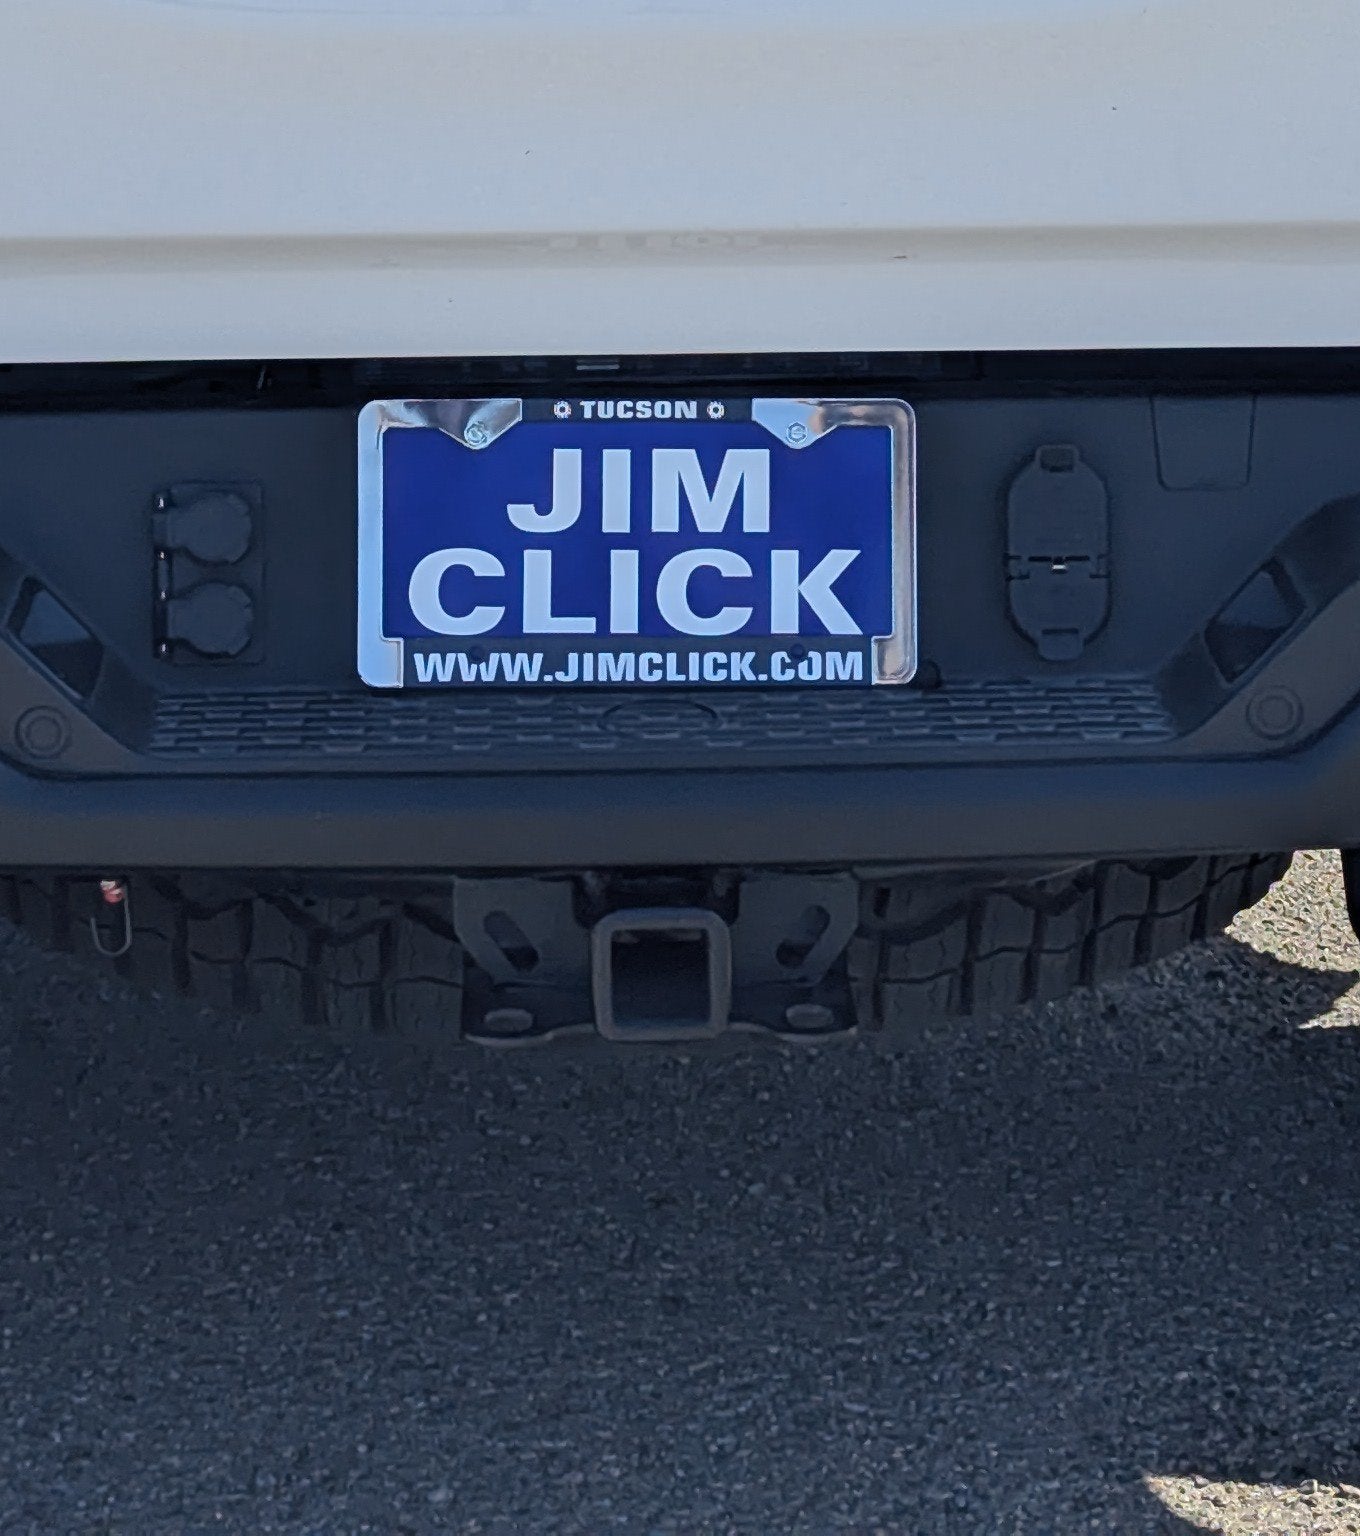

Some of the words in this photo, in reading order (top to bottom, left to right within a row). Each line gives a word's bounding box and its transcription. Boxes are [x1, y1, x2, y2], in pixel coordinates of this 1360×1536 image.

[579, 400, 698, 420] TUCSON
[506, 447, 771, 534] JIM
[407, 546, 863, 637] CLICK
[413, 650, 864, 683] WWW.JIMCLICK.COM
